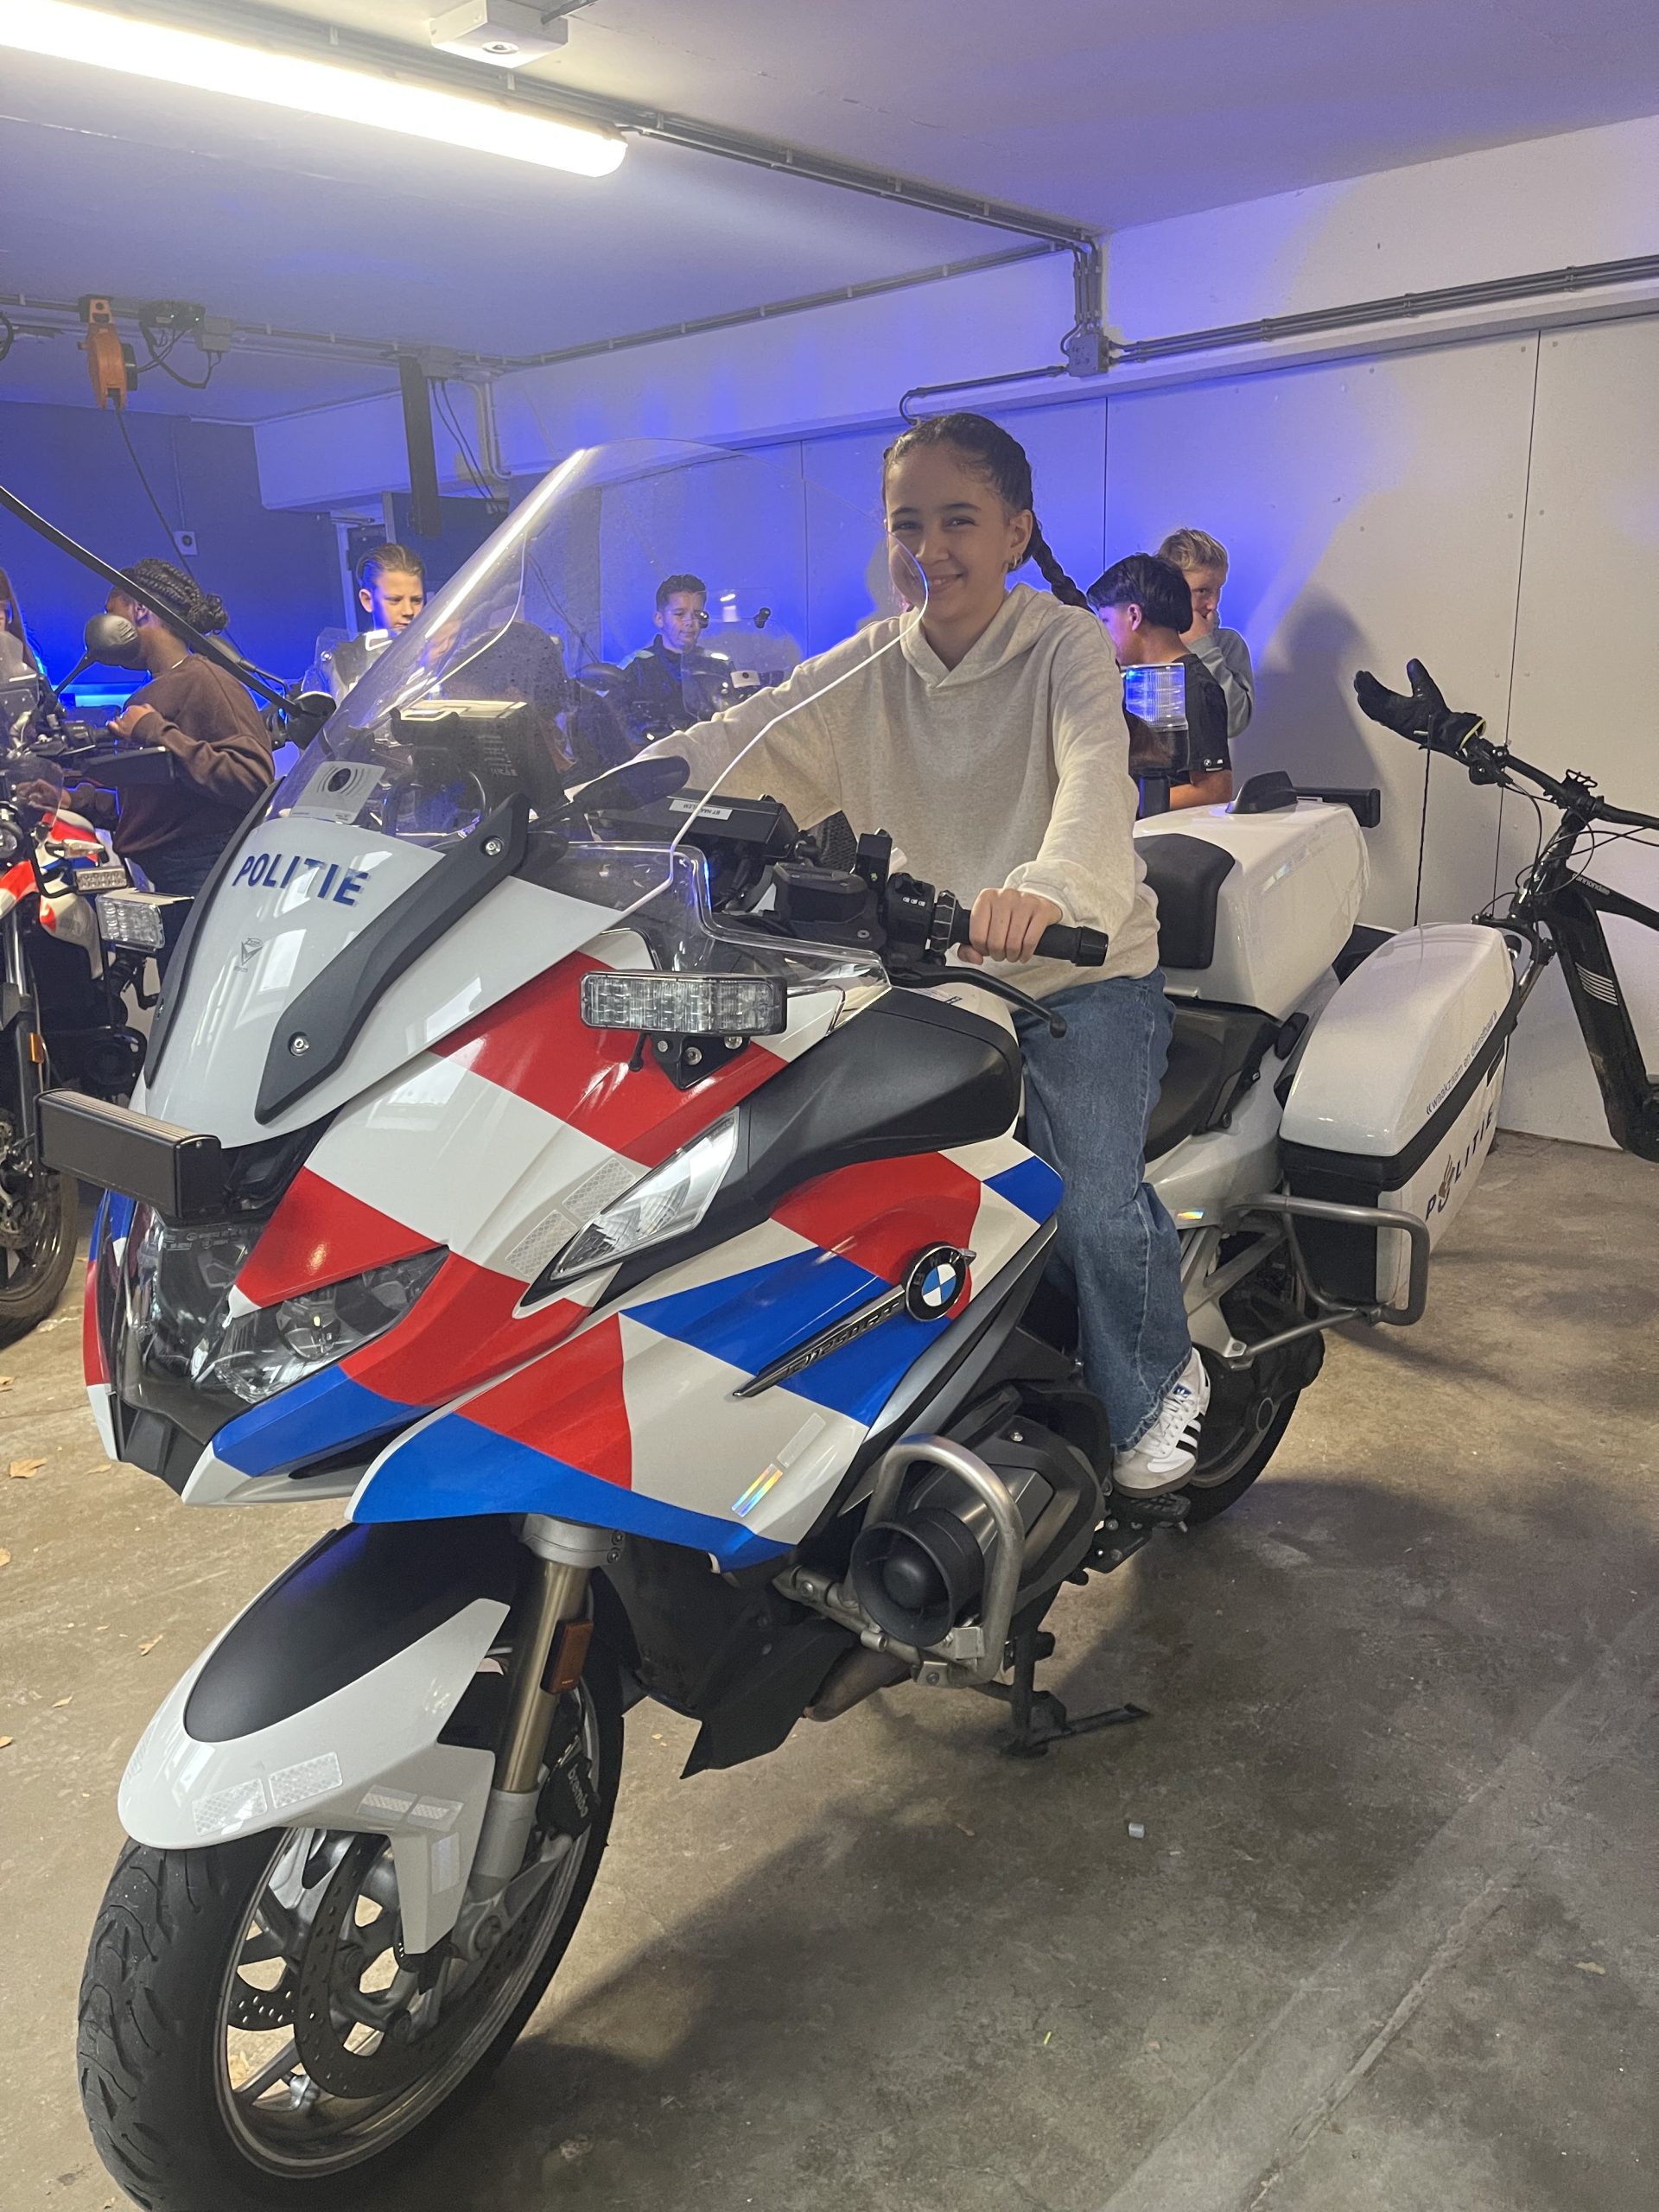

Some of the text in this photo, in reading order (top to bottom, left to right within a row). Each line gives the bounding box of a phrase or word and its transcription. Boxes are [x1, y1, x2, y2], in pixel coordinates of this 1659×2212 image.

[683, 804, 712, 814] HAALEM
[232, 854, 370, 906] POLITIE
[568, 1764, 588, 1819] brembo
